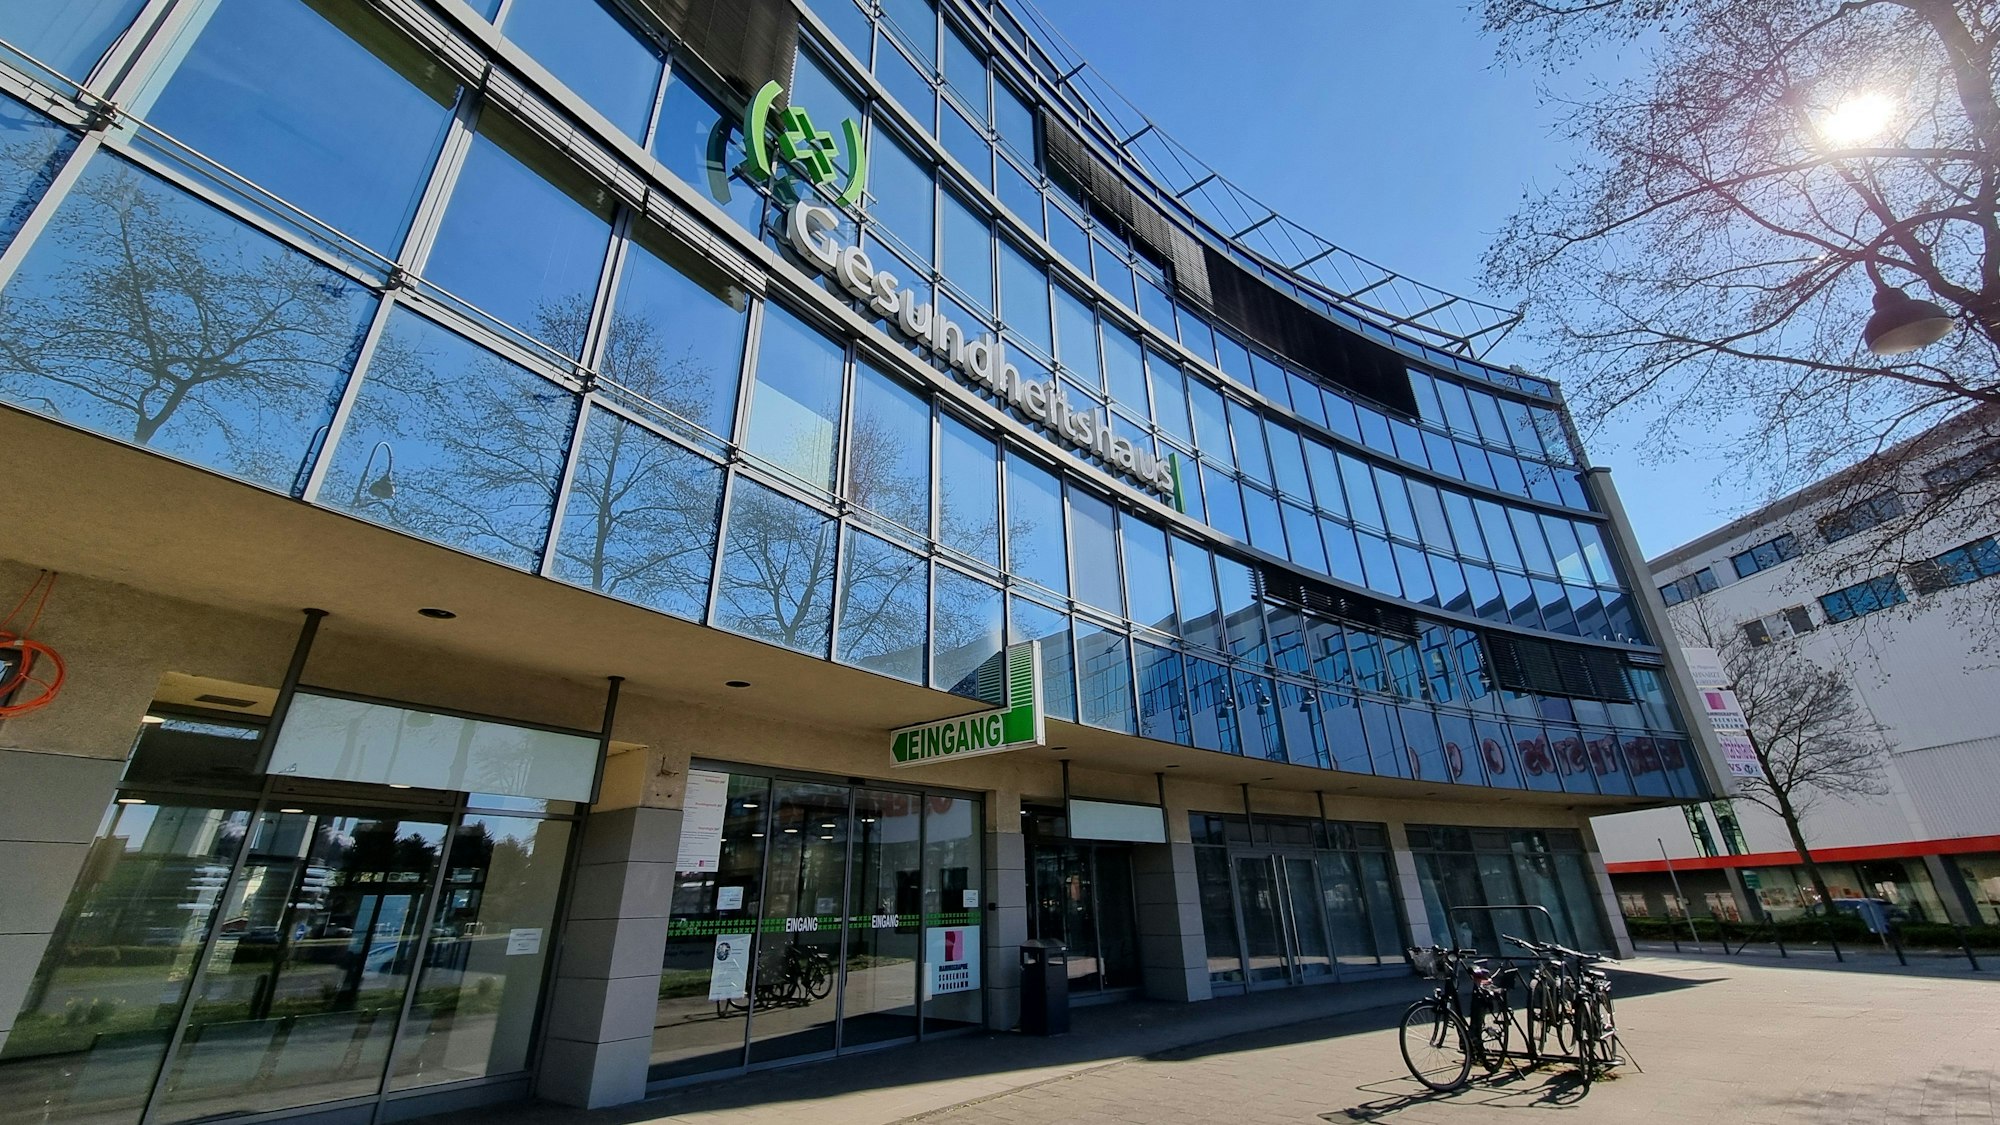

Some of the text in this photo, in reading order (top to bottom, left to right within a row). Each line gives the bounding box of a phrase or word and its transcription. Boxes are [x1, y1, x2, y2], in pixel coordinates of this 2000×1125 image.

[785, 200, 1174, 493] Gesundheitshaus
[908, 714, 1000, 760] EINGANG
[785, 917, 818, 932] EINGANG
[871, 914, 899, 928] EINGANG
